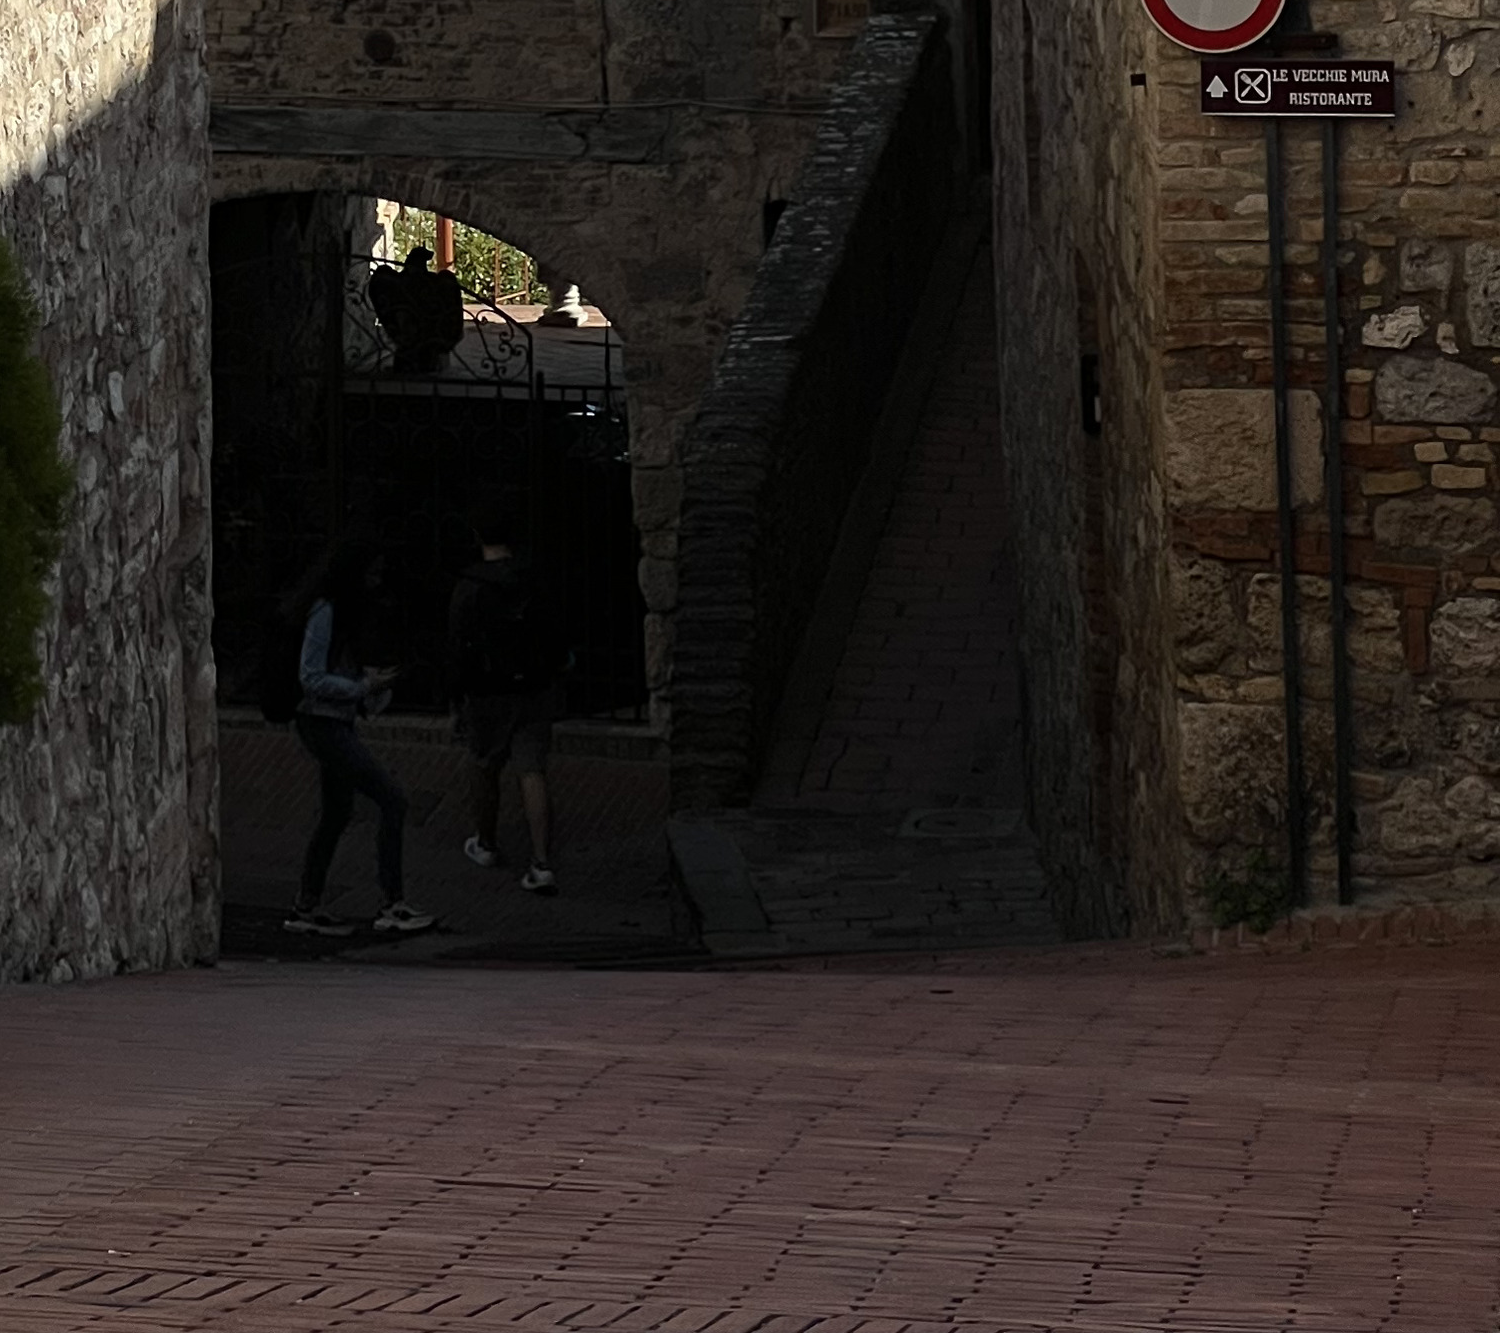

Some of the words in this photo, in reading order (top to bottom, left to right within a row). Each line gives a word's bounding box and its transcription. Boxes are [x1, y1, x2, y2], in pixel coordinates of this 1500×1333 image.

[1272, 68, 1288, 82] LE
[1291, 68, 1347, 83] VECCHIE
[1351, 69, 1390, 83] MURA
[1289, 92, 1373, 106] RISTORANTE
